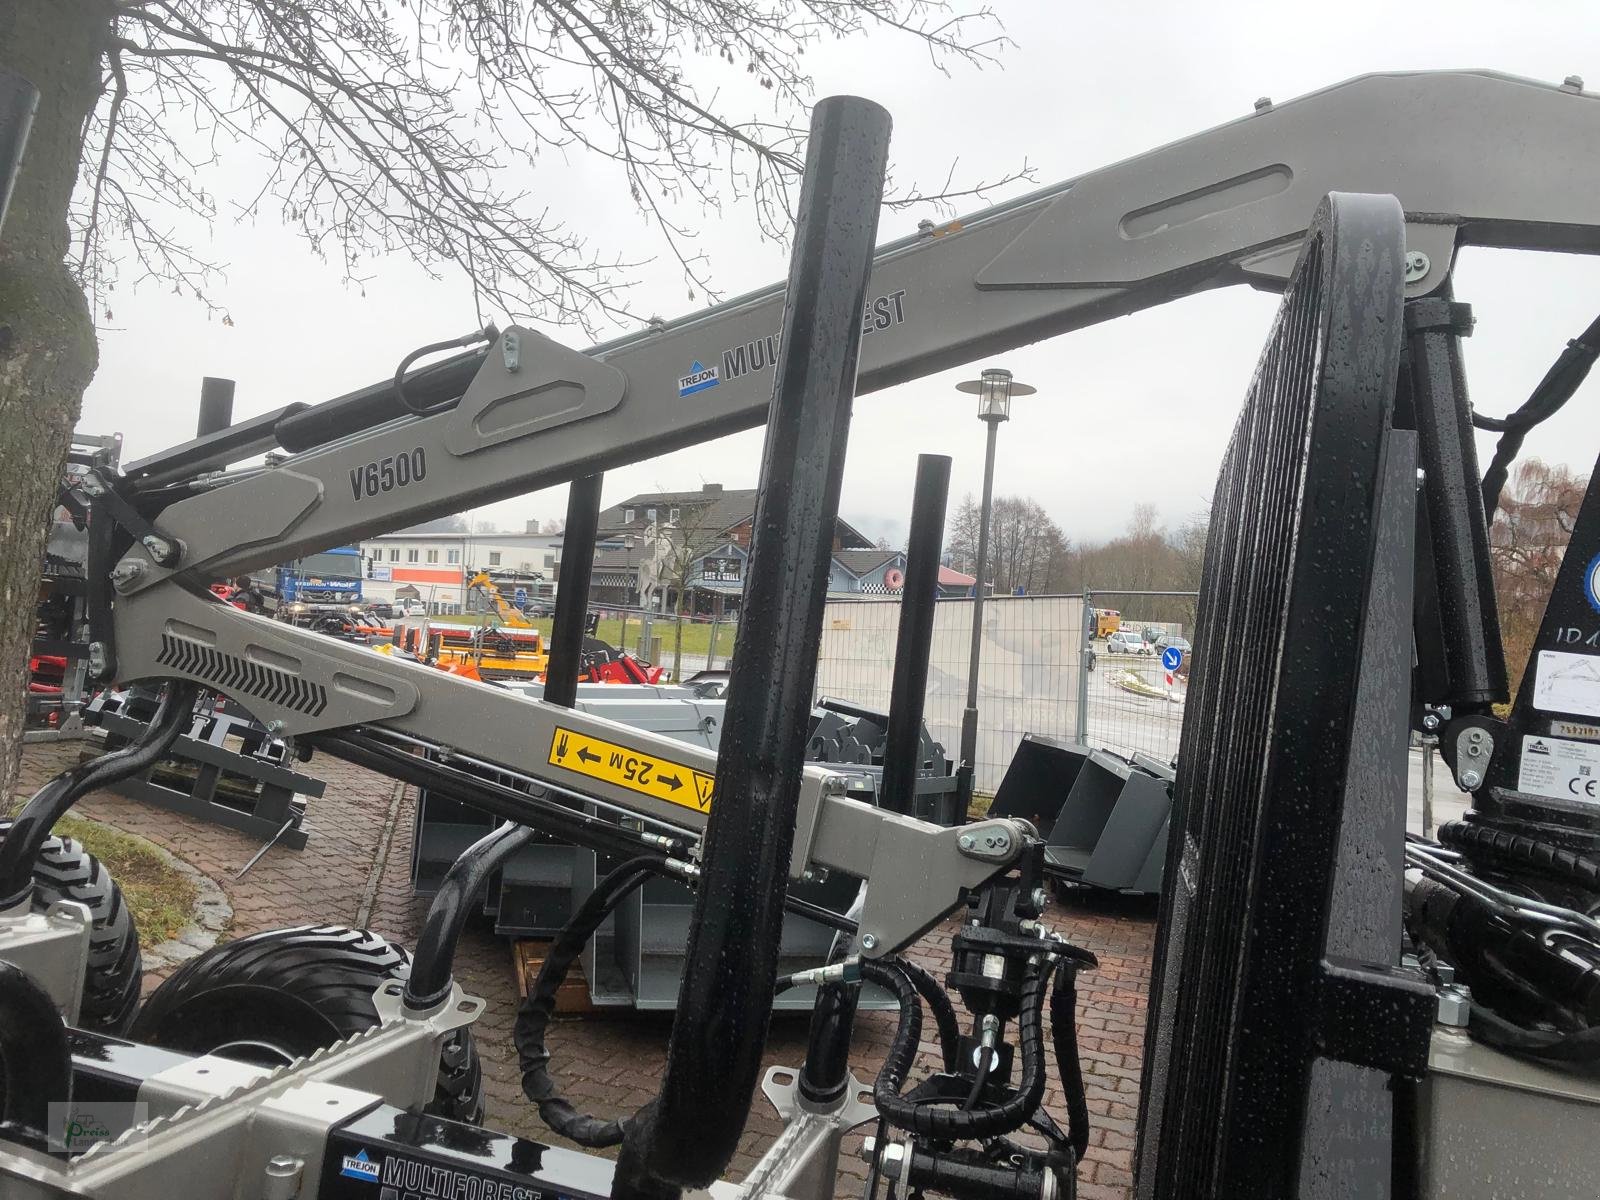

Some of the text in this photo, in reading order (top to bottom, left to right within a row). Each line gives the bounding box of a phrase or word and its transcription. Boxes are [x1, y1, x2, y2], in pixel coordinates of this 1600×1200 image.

[679, 371, 717, 388] TREJON
[350, 446, 427, 501] V6500
[608, 751, 655, 785] 25M
[345, 1159, 378, 1173] TREJON
